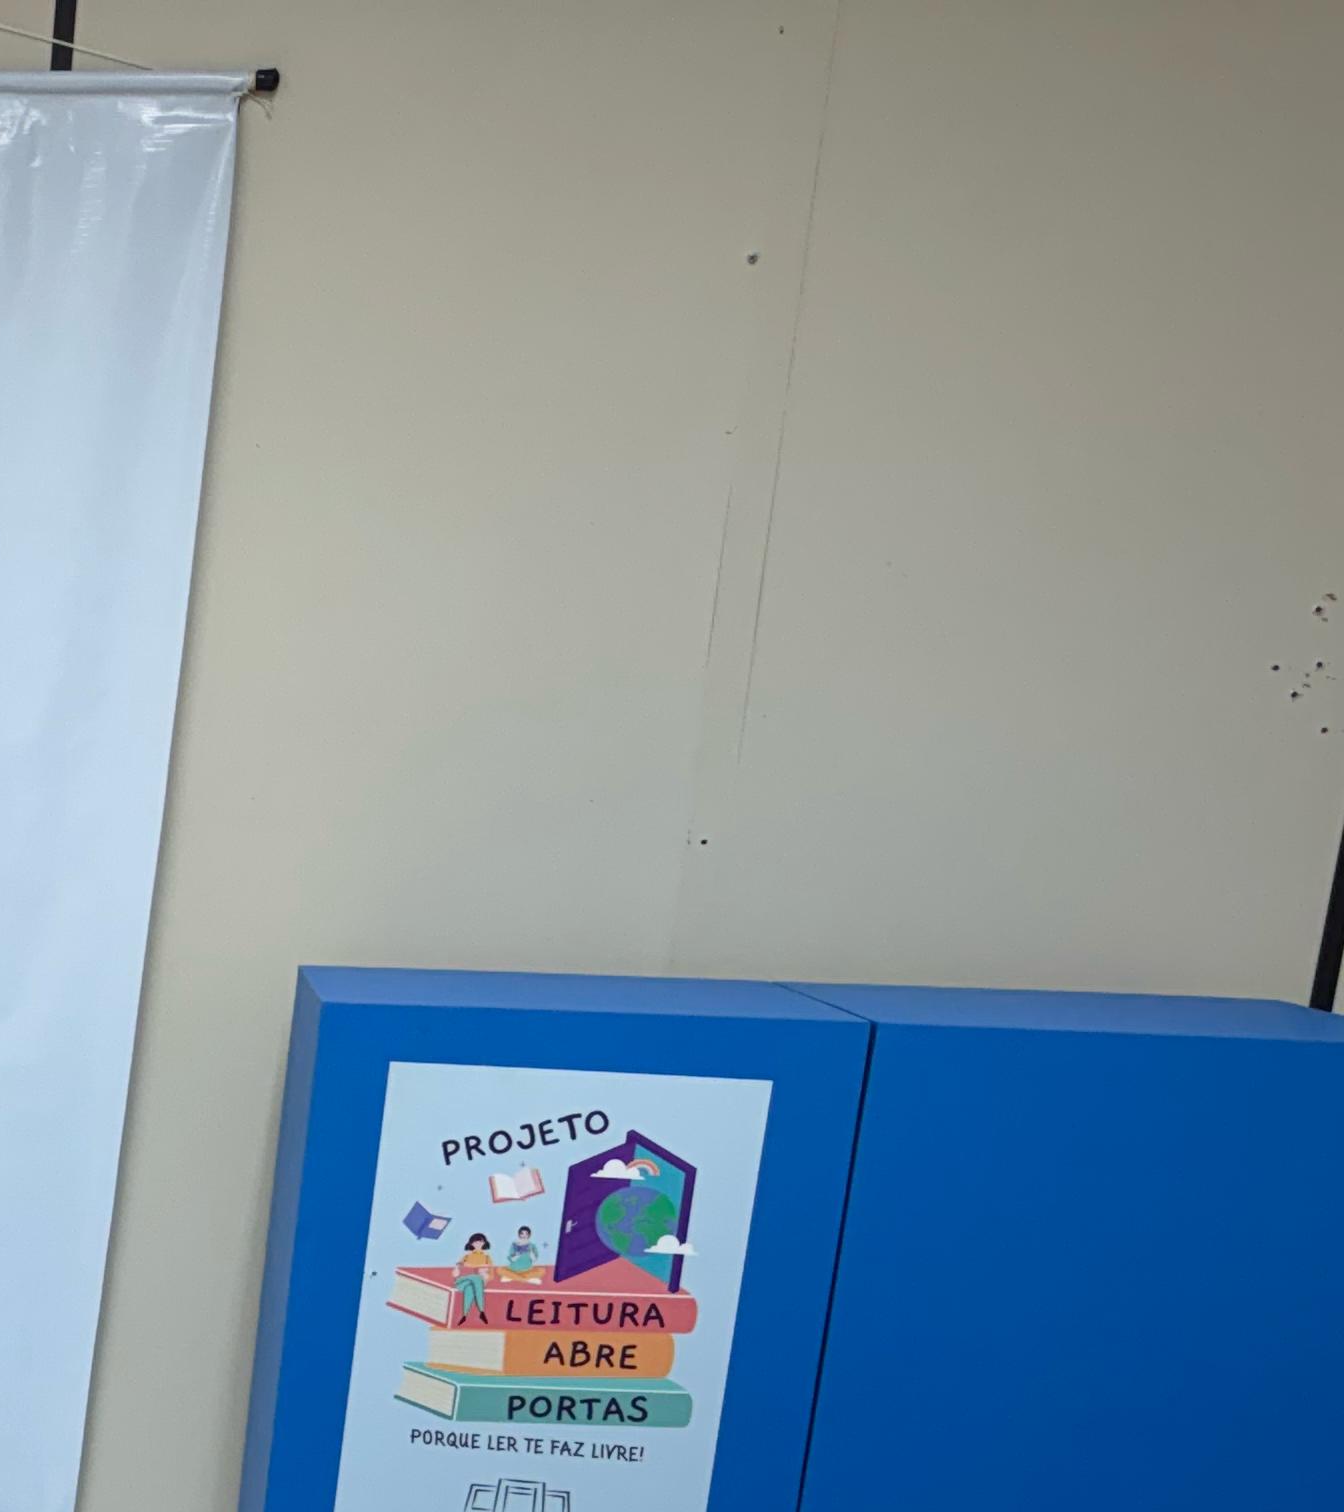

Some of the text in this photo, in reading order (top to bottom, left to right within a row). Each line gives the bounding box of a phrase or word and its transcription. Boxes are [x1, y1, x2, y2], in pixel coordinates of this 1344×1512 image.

[442, 1110, 610, 1166] PROJETO
[506, 1299, 665, 1329] LEITURA
[543, 1341, 638, 1370] ABRE
[508, 1395, 648, 1423] PORTAS
[410, 1428, 645, 1462] PORQUE LER TE FAZ LIVRE!
